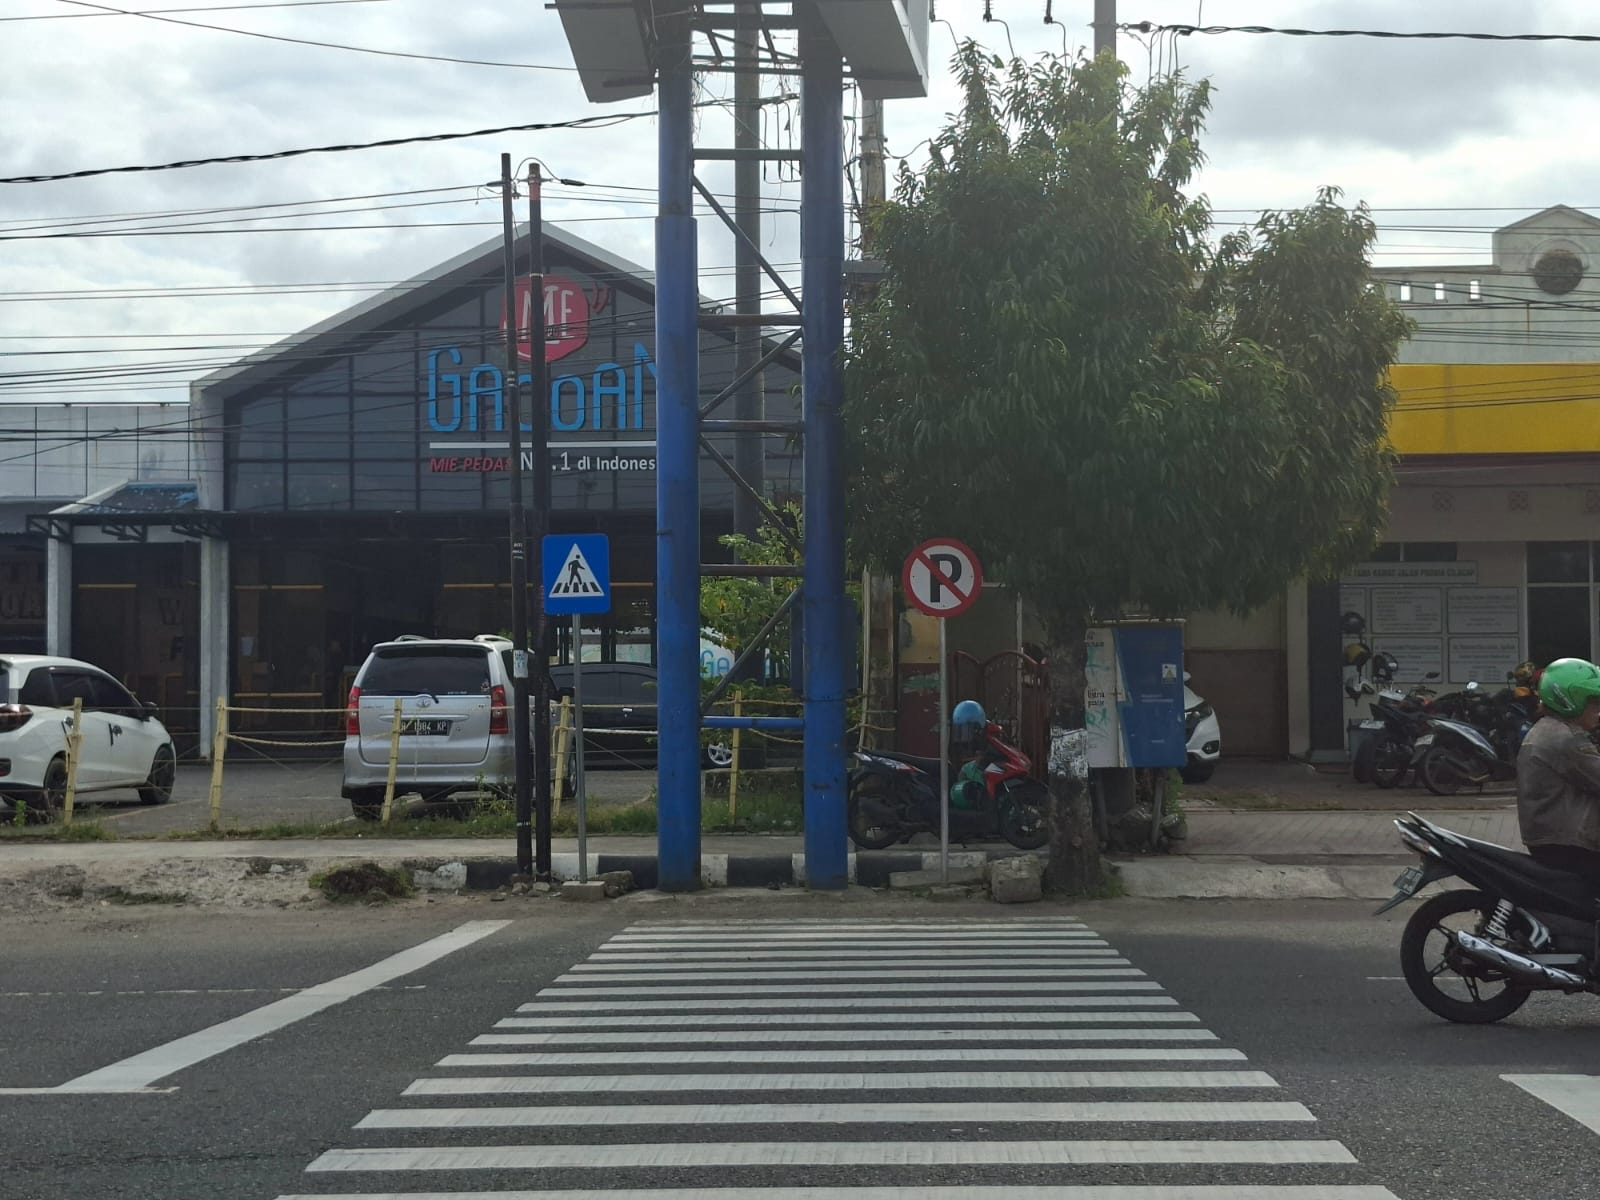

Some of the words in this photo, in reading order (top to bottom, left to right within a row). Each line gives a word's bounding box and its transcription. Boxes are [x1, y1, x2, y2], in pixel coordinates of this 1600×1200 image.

[430, 457, 458, 472] MIE
[520, 451, 571, 471] N.1
[930, 553, 962, 603] P
